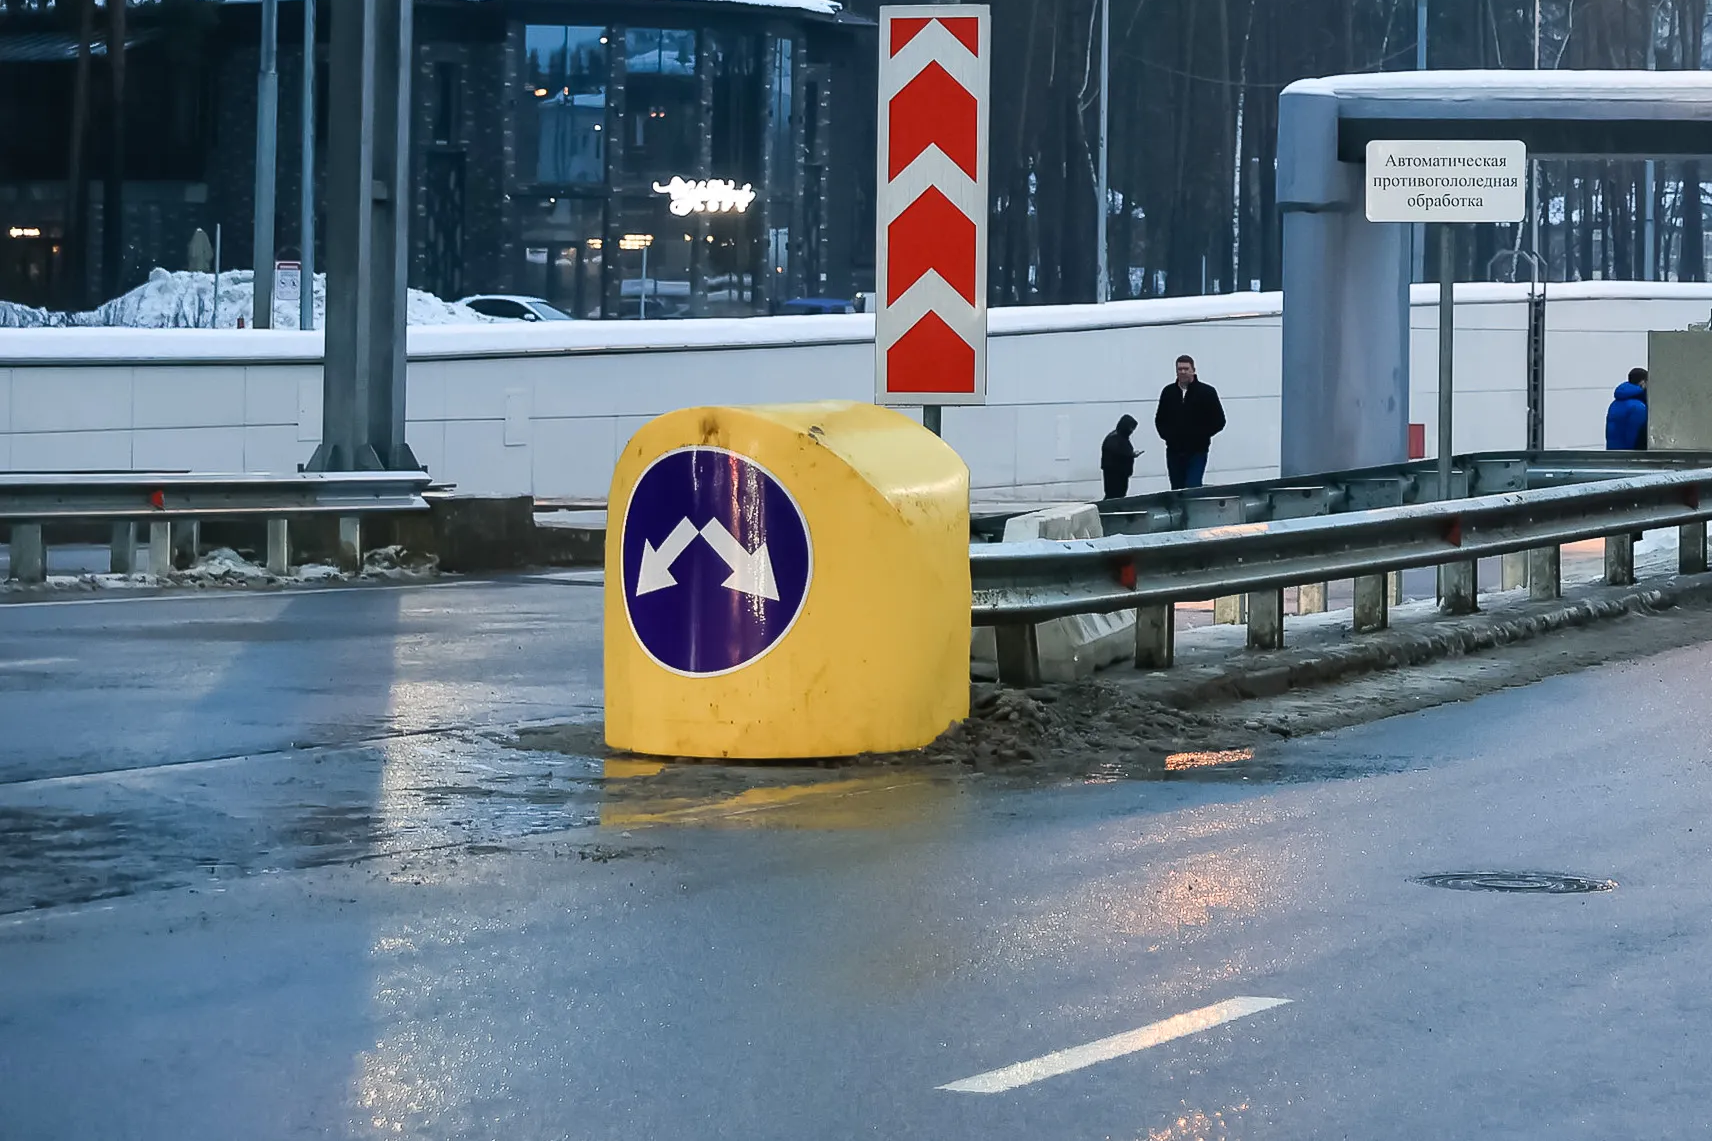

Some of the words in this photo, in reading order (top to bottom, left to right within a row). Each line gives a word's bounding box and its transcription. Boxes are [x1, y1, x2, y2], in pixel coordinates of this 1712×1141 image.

[1385, 154, 1507, 168] Автоматическая
[1373, 176, 1518, 190] противогололедная
[1407, 193, 1484, 210] обработка
